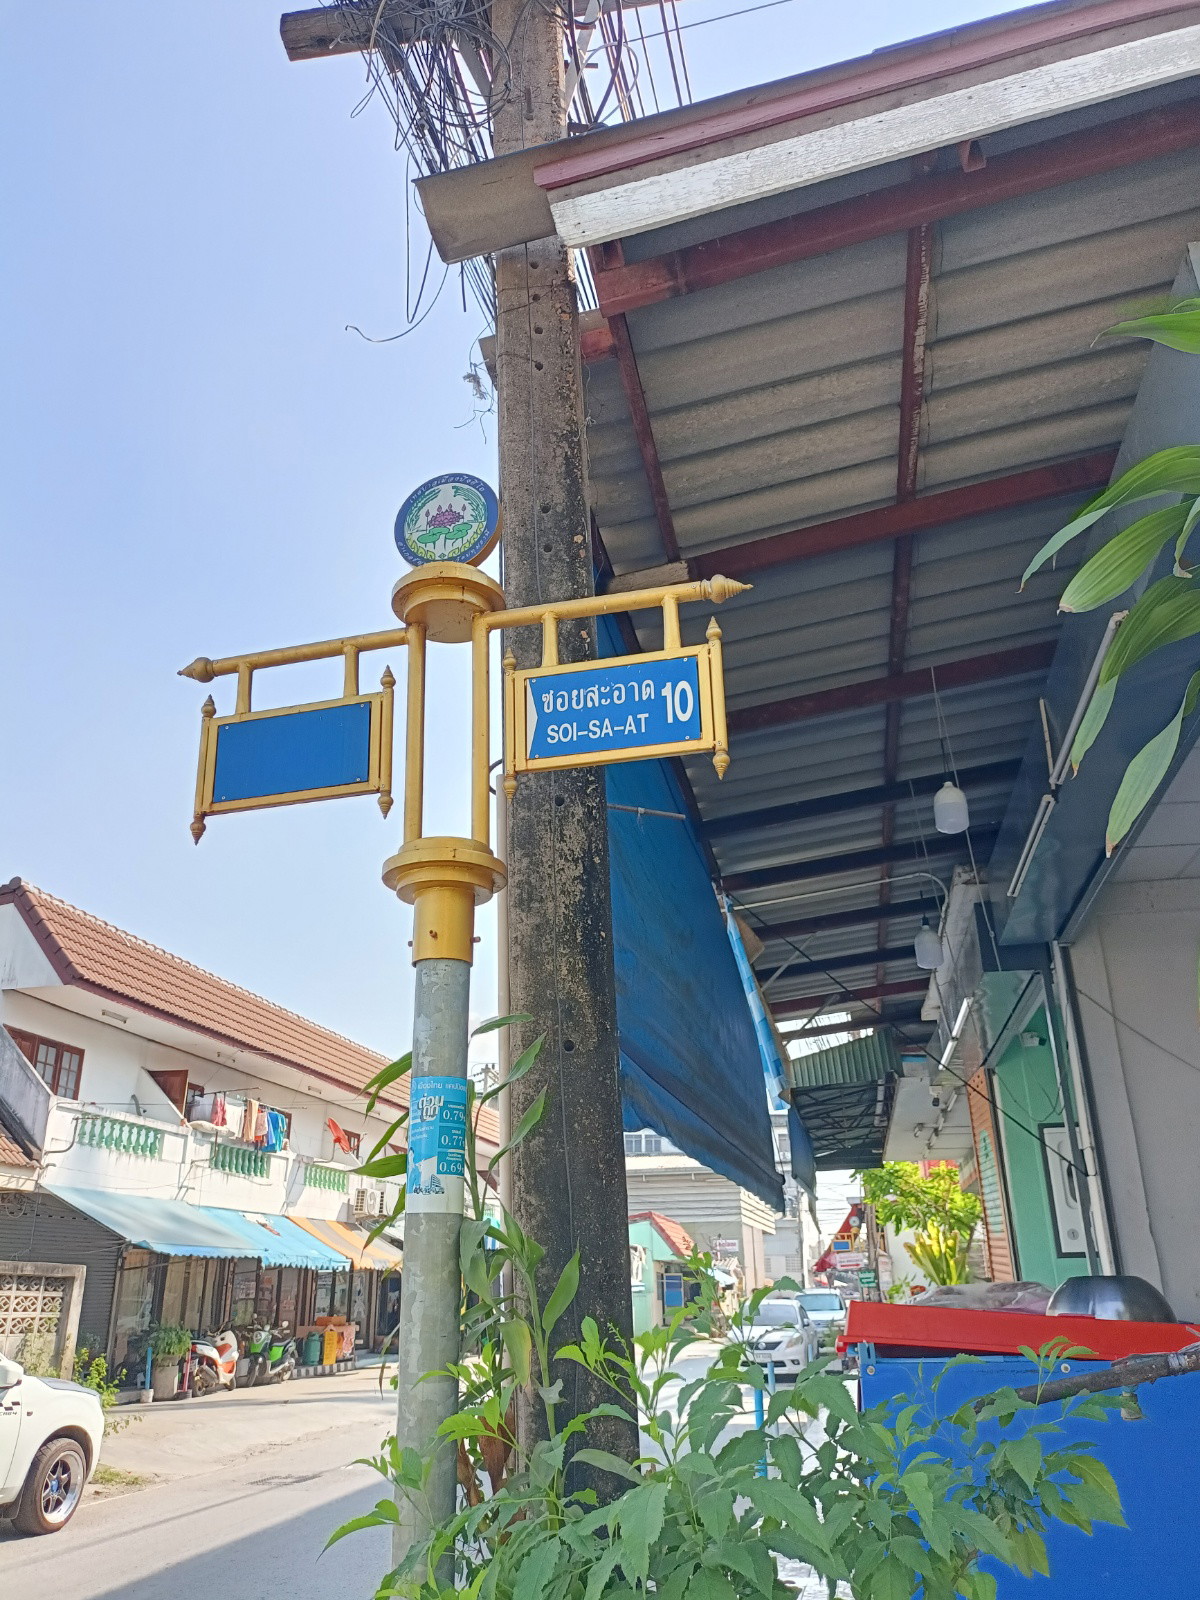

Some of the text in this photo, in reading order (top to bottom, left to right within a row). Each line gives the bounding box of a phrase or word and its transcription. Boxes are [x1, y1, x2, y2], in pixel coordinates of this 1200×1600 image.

[541, 679, 694, 724] ซอยสะอาด 10
[546, 713, 650, 744] SOI-SA-AT
